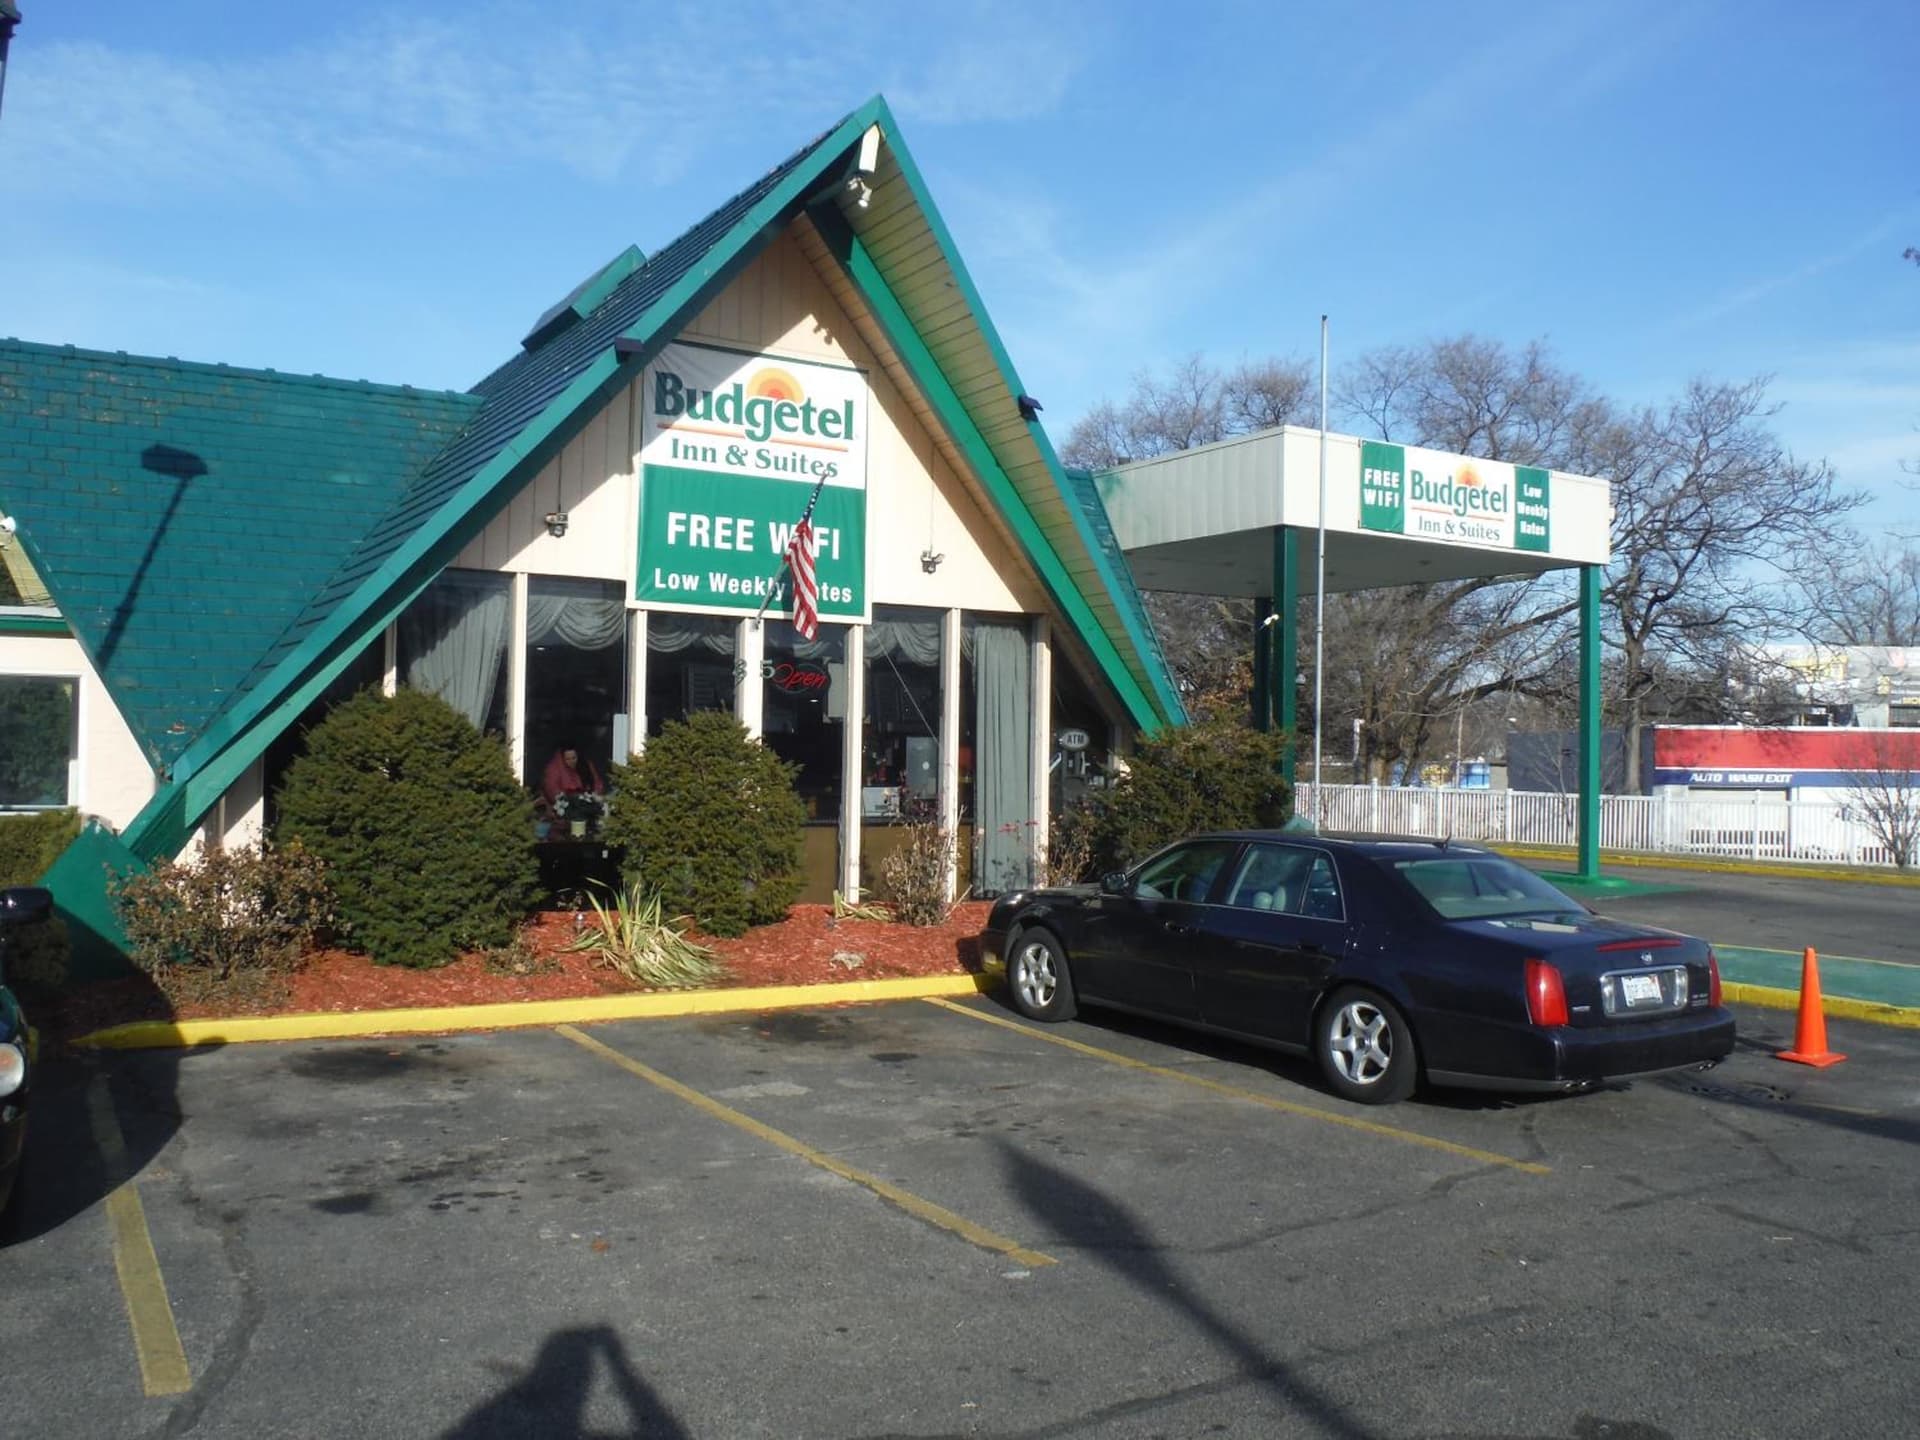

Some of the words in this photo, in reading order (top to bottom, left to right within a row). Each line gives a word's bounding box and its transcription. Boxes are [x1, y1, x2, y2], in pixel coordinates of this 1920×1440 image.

[654, 370, 854, 442] Budgetel
[671, 438, 717, 463] Inn
[725, 445, 748, 466] &
[755, 448, 838, 477] Suites
[1364, 468, 1400, 489] FREE
[1410, 470, 1507, 517] Budgetel
[1364, 488, 1400, 508] WIFI
[667, 511, 755, 552] FREE
[769, 521, 840, 560] WFI
[1418, 515, 1441, 533] Inn
[1444, 522, 1455, 535] &
[1459, 522, 1500, 541] Suites
[654, 568, 699, 591] Low
[806, 580, 852, 603] tes
[772, 663, 828, 689] Open
[1689, 772, 1722, 782] AUTO
[1765, 774, 1792, 783] EXIT
